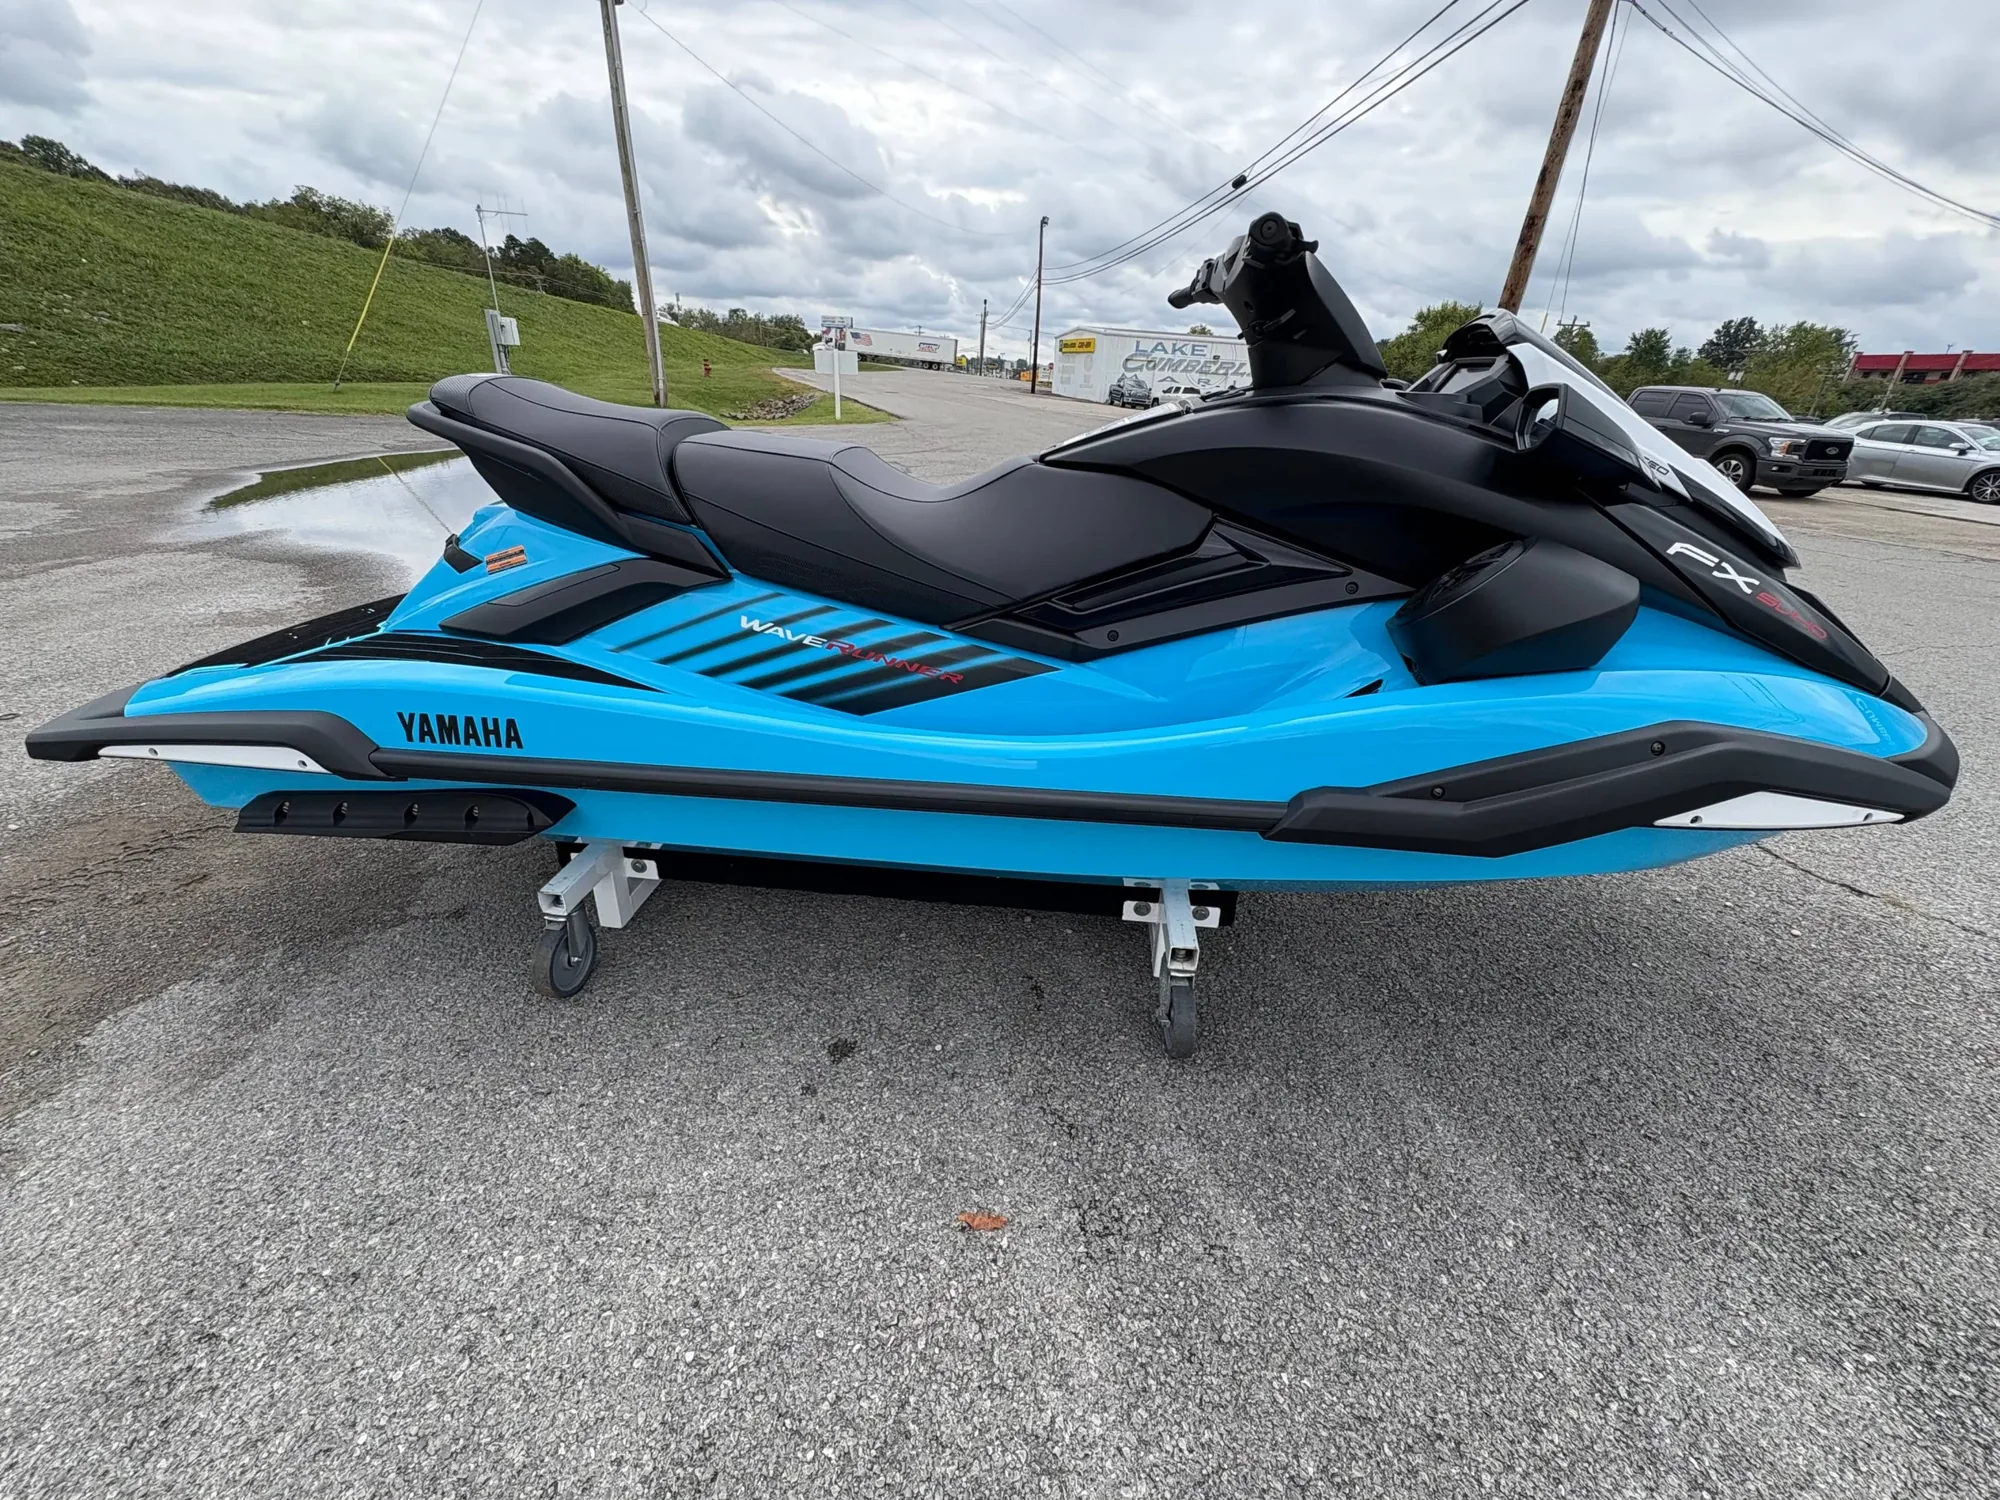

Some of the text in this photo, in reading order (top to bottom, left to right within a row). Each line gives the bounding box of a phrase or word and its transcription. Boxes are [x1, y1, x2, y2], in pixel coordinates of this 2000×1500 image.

[1122, 352, 1252, 378] CUMBERL
[1135, 340, 1208, 357] LAKE
[1666, 541, 1760, 595] FX
[740, 615, 964, 684] WAVERUNNER
[396, 711, 524, 749] YAMAHA
